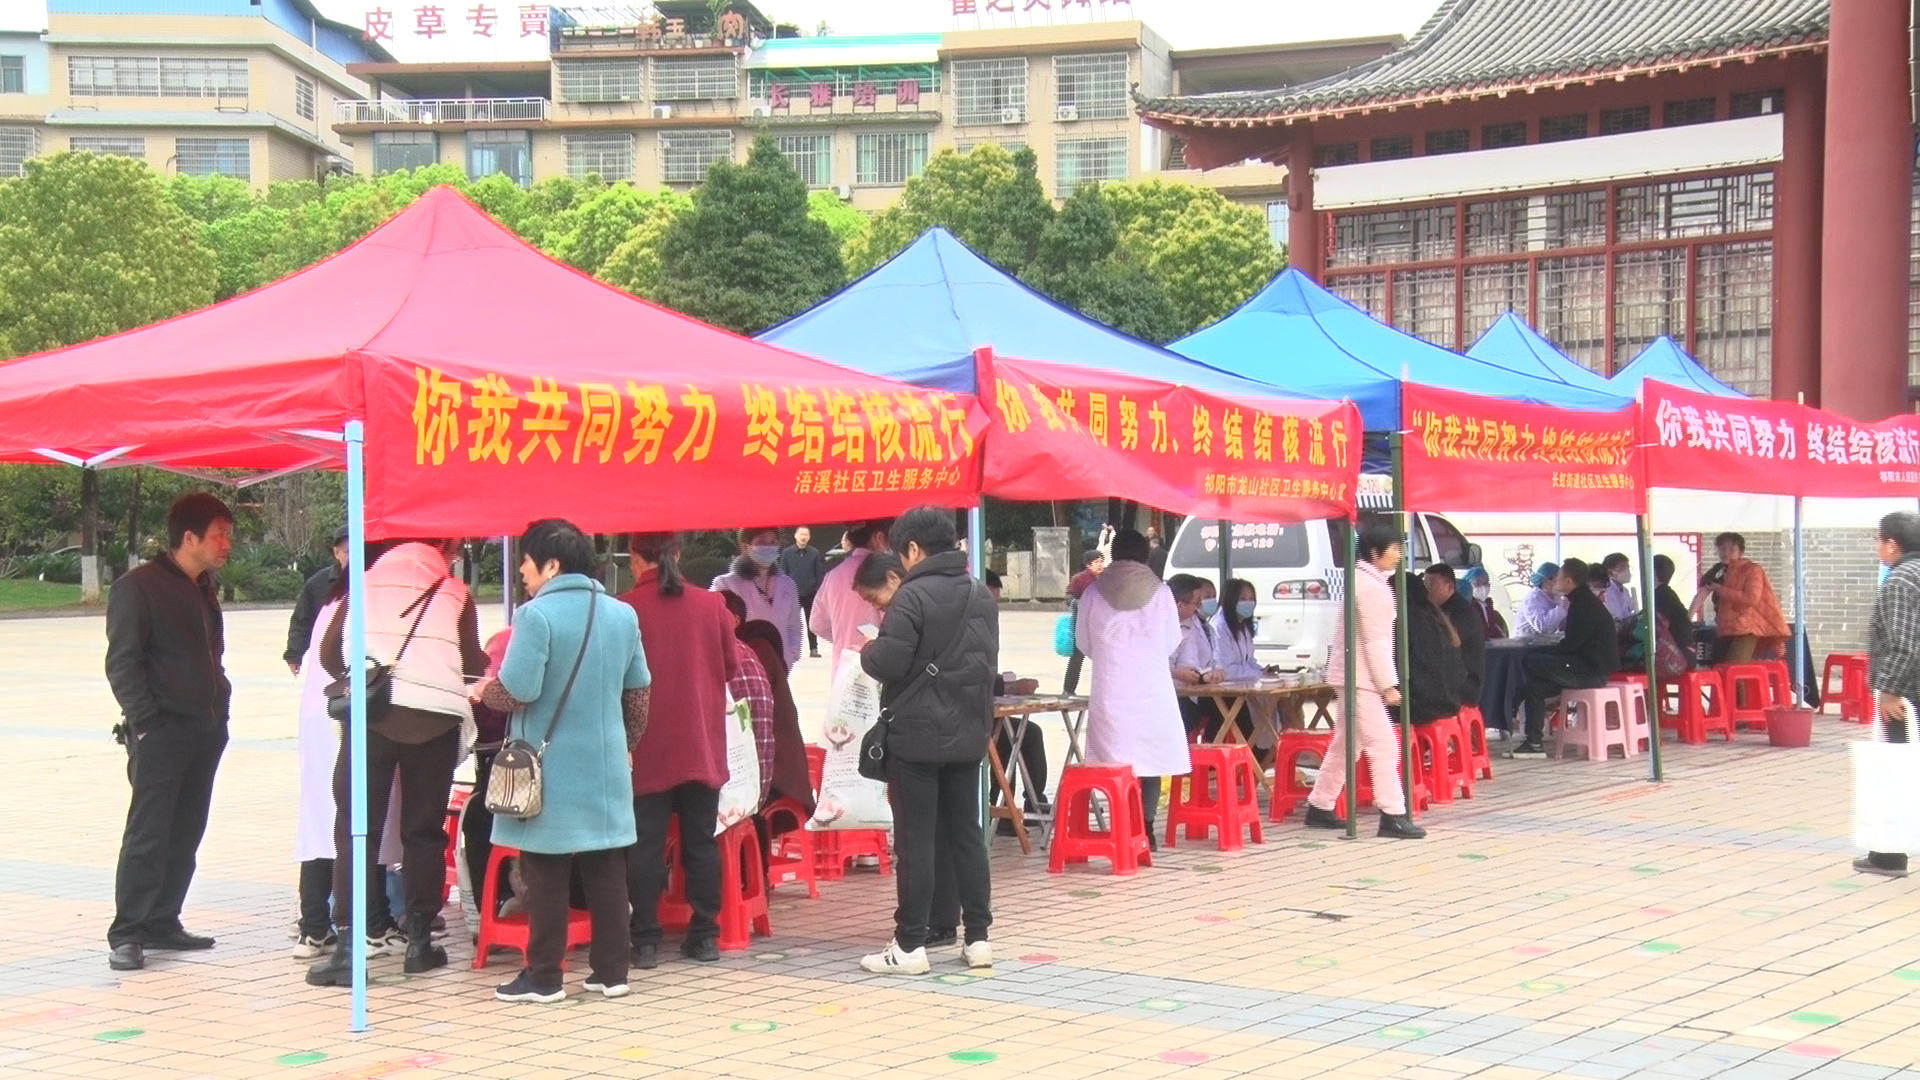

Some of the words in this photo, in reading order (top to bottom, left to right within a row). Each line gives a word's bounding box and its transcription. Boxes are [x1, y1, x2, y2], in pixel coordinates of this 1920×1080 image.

[361, 3, 550, 40] 皮草专賣
[411, 366, 717, 466] 你我共同努力
[740, 383, 974, 466] 终结结核流行
[1655, 398, 1796, 460] 你我共同努力
[794, 466, 960, 494] 浯溪社区卫生服务中心
